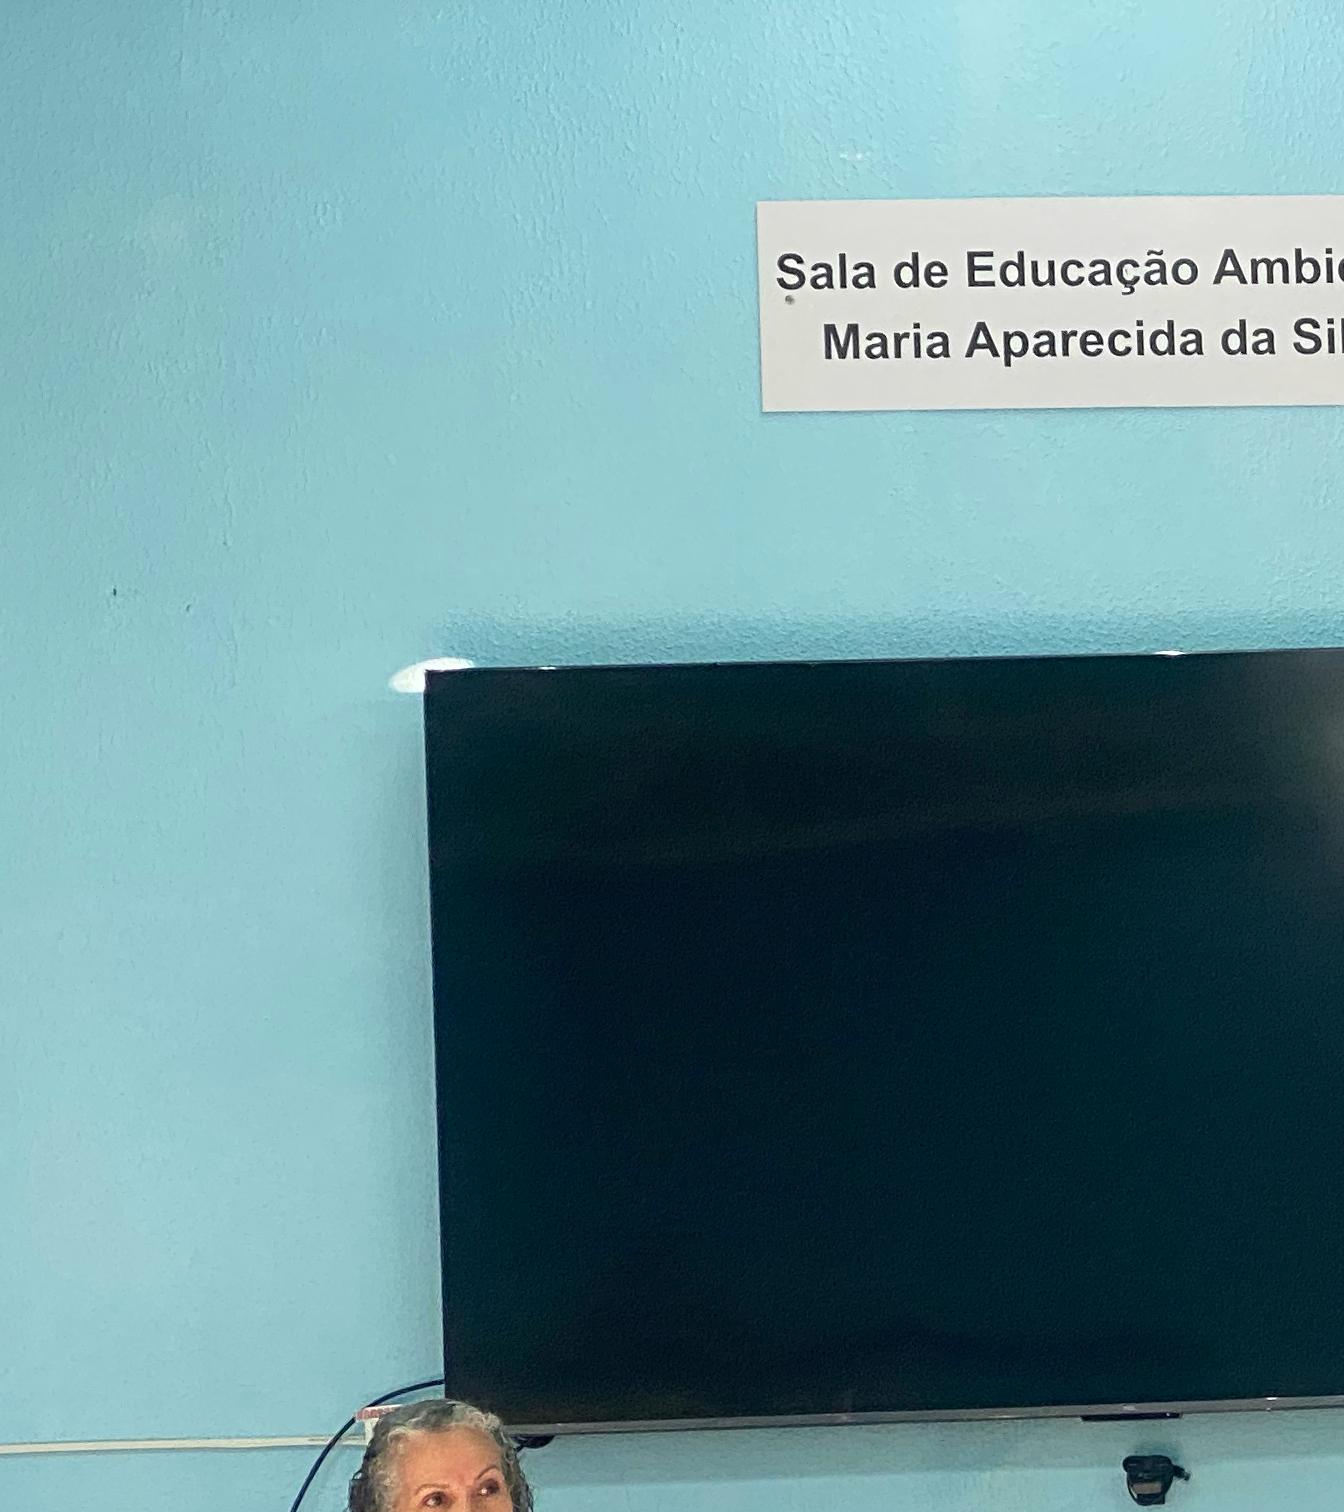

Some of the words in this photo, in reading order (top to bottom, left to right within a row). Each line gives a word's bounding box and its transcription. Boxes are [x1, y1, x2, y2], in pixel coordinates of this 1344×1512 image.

[776, 252, 876, 290] Sala
[893, 251, 949, 289] de
[966, 249, 1199, 296] Educação
[823, 322, 951, 360] Maria
[965, 319, 1204, 367] Aparecida
[1221, 319, 1276, 356] da
